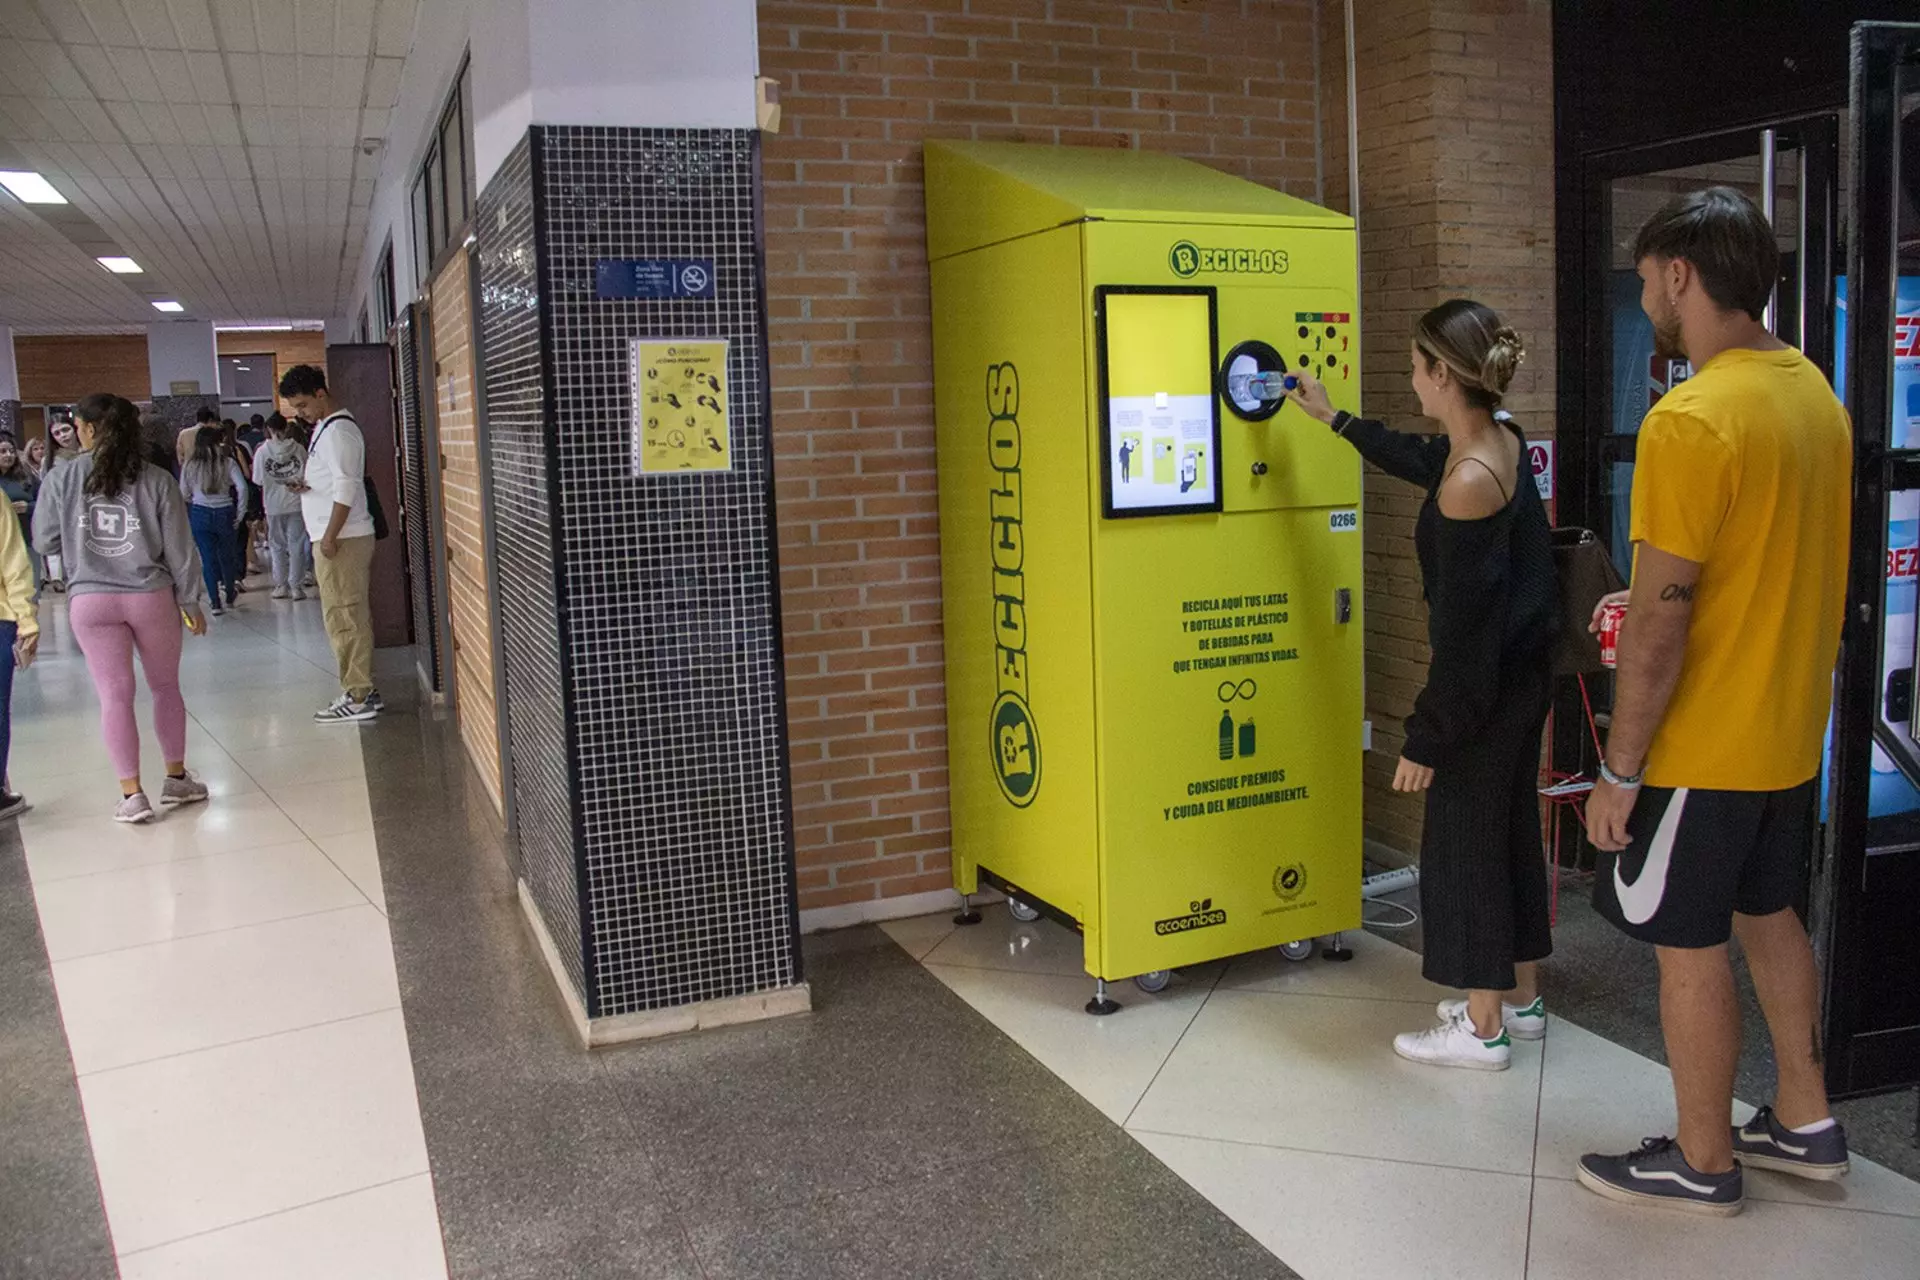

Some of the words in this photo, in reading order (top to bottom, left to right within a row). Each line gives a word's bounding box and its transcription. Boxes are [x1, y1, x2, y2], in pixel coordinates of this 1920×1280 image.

[1168, 240, 1288, 279] RECICLOS
[1330, 513, 1357, 527] 0266
[986, 361, 1042, 808] RECICLOS
[1182, 598, 1220, 613] RECICLA
[1221, 595, 1243, 611] AQUÍ
[1245, 595, 1261, 607] TUS
[1263, 593, 1288, 606] LATAS
[1182, 620, 1188, 632] Y
[1190, 617, 1233, 632] BOTELLAS
[1235, 615, 1245, 628] DE
[1247, 611, 1288, 627] PLÁSTICO
[1199, 638, 1210, 650] DE
[1212, 634, 1249, 649] BEBIDAS
[1251, 632, 1273, 645] PARA
[1173, 659, 1191, 673] QUE
[1192, 655, 1226, 671] TENGAN
[1228, 651, 1270, 667] INFINITAS
[1271, 648, 1299, 662] VIDAS.
[1187, 775, 1239, 796] CONSIGUE
[1241, 769, 1285, 788] PREMIOS
[1163, 807, 1170, 821] Y
[1173, 803, 1205, 820] CUIDA
[1207, 799, 1225, 815] DEL
[1227, 786, 1309, 811] MEDIOAMBIENTE.
[1156, 912, 1225, 934] ecoembes
